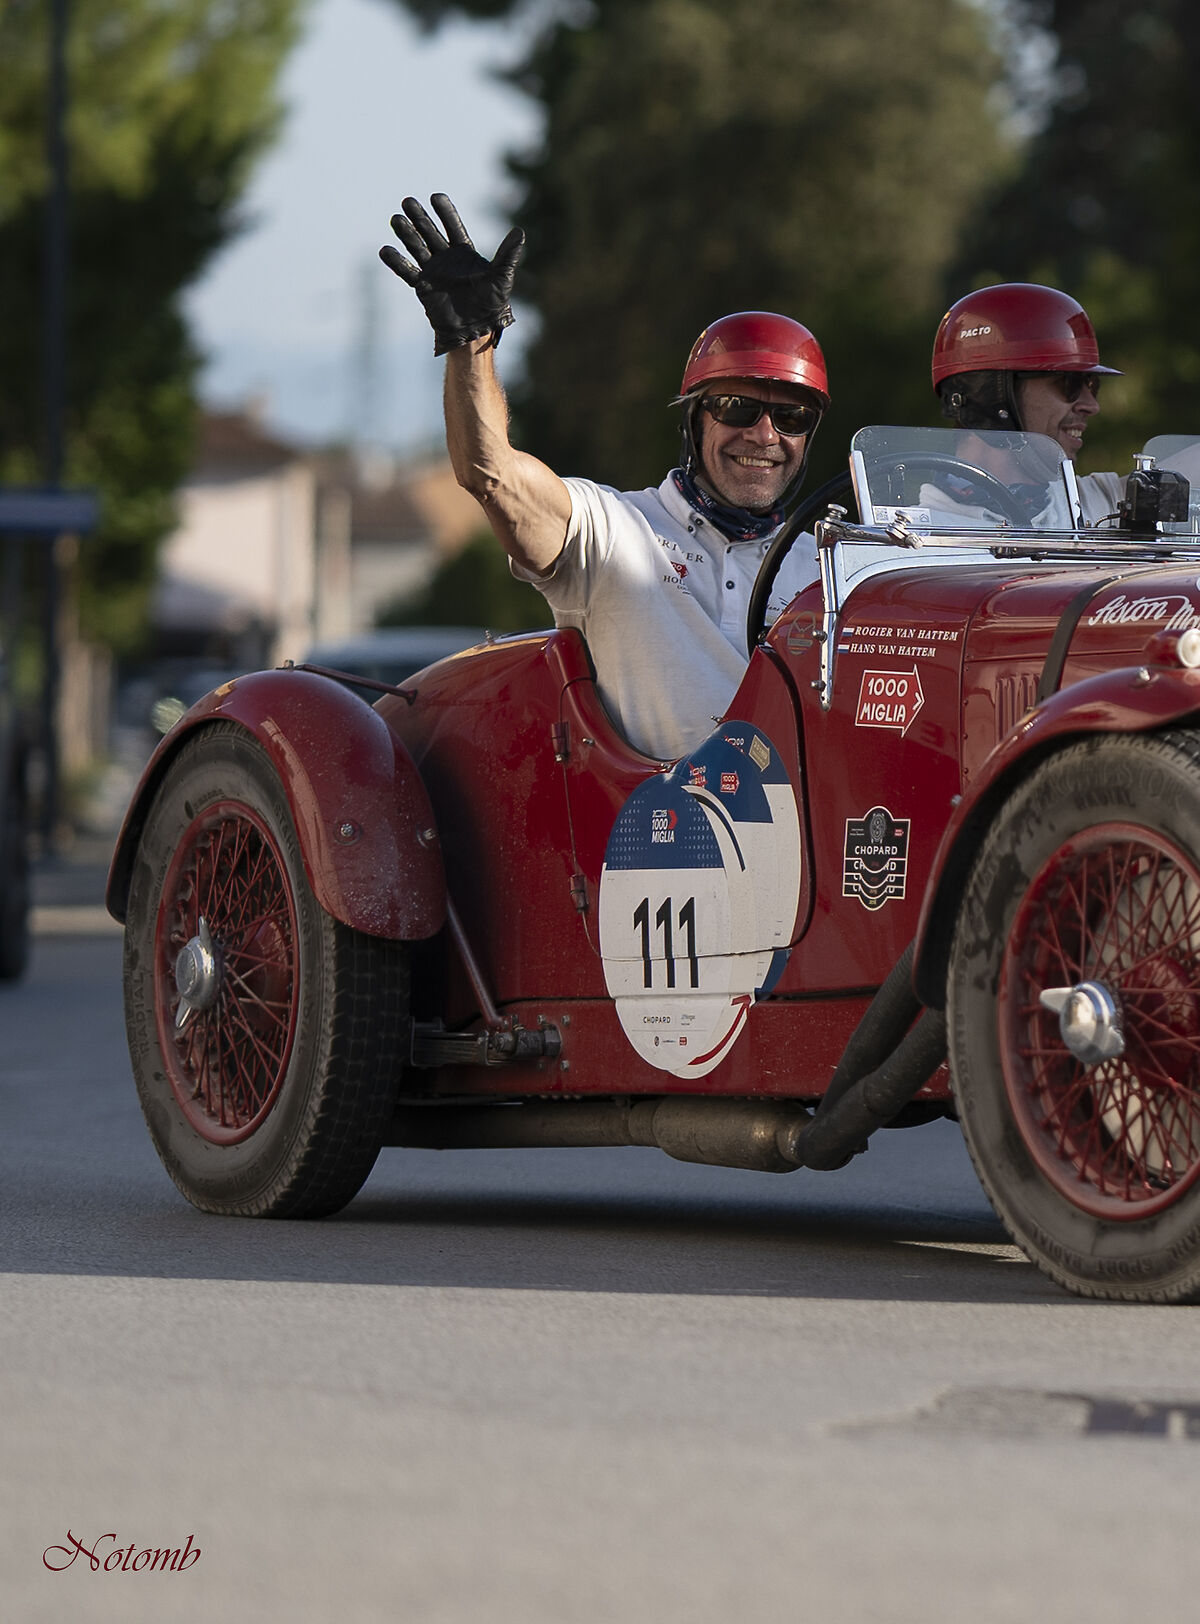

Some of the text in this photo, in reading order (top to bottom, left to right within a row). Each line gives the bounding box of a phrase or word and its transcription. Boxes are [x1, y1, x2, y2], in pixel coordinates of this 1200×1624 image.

[960, 326, 991, 339] PACTO
[1088, 595, 1188, 626] Aston
[854, 626, 959, 641] ROGIER VAN HATTEM
[850, 643, 937, 658] HANS VAN HATTEM
[867, 678, 909, 697] 1000
[859, 703, 906, 723] MIGLIA
[652, 818, 668, 830] 1000
[651, 830, 675, 843] MIGLIA
[854, 845, 898, 855] CHOPARD
[633, 896, 699, 989] 111
[643, 1016, 671, 1024] CHOPARD
